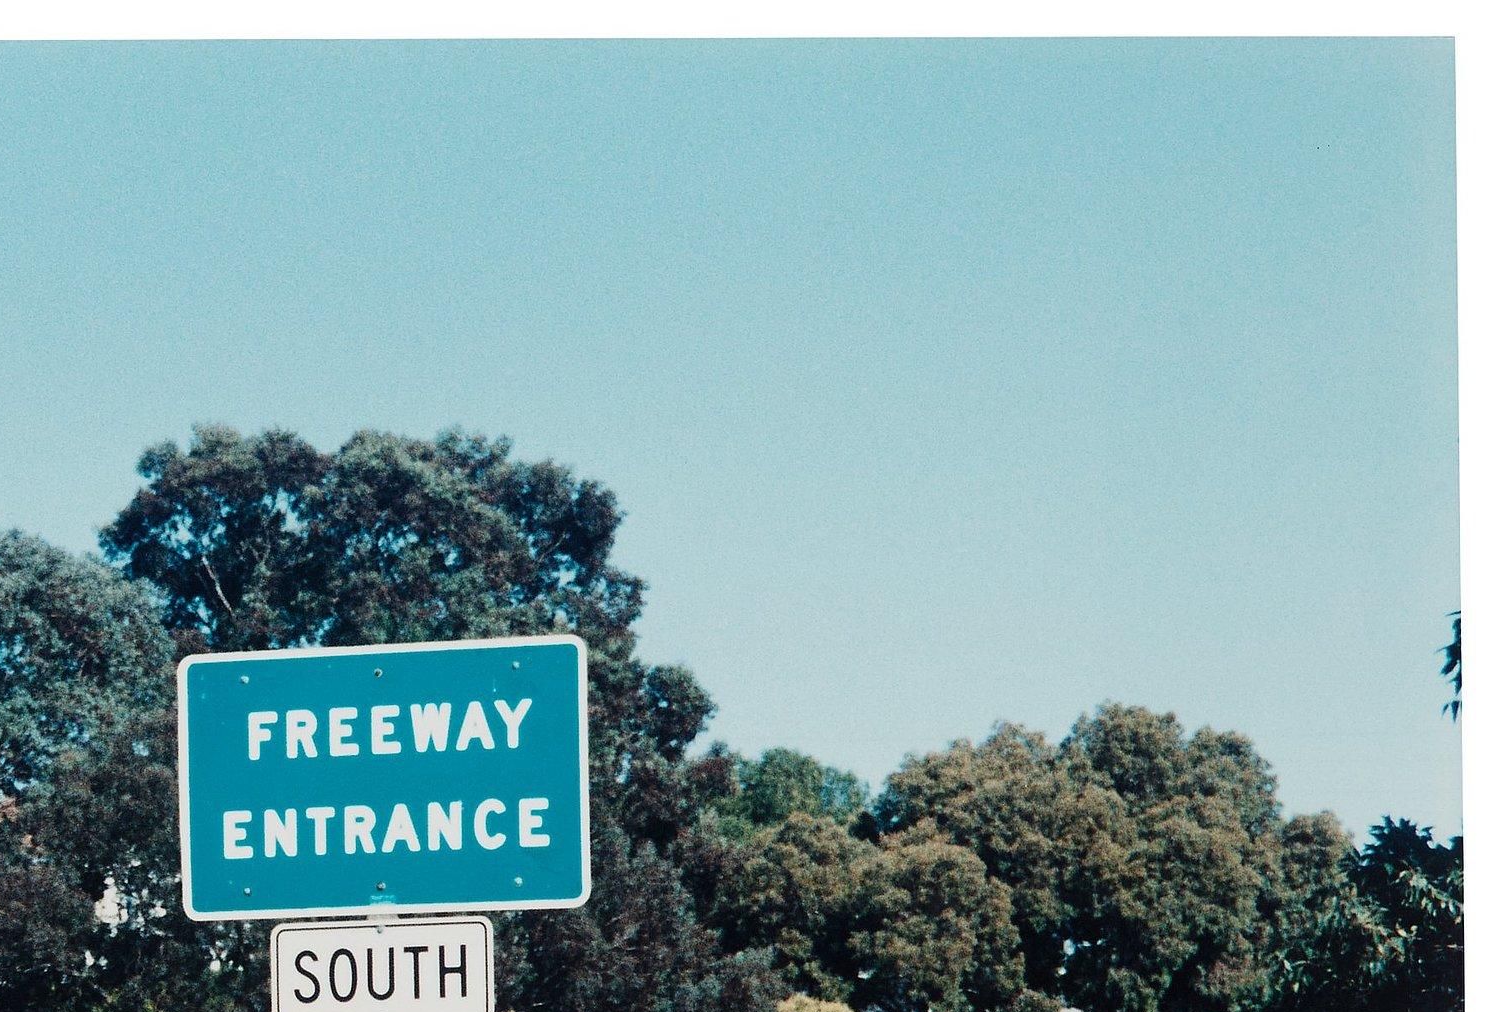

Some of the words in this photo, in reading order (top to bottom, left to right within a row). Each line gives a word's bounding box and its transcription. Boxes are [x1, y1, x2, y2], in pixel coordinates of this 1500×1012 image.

[248, 698, 533, 760] FREEWAY
[223, 798, 550, 859] ENTRANCE
[294, 944, 468, 1003] SOUTH
